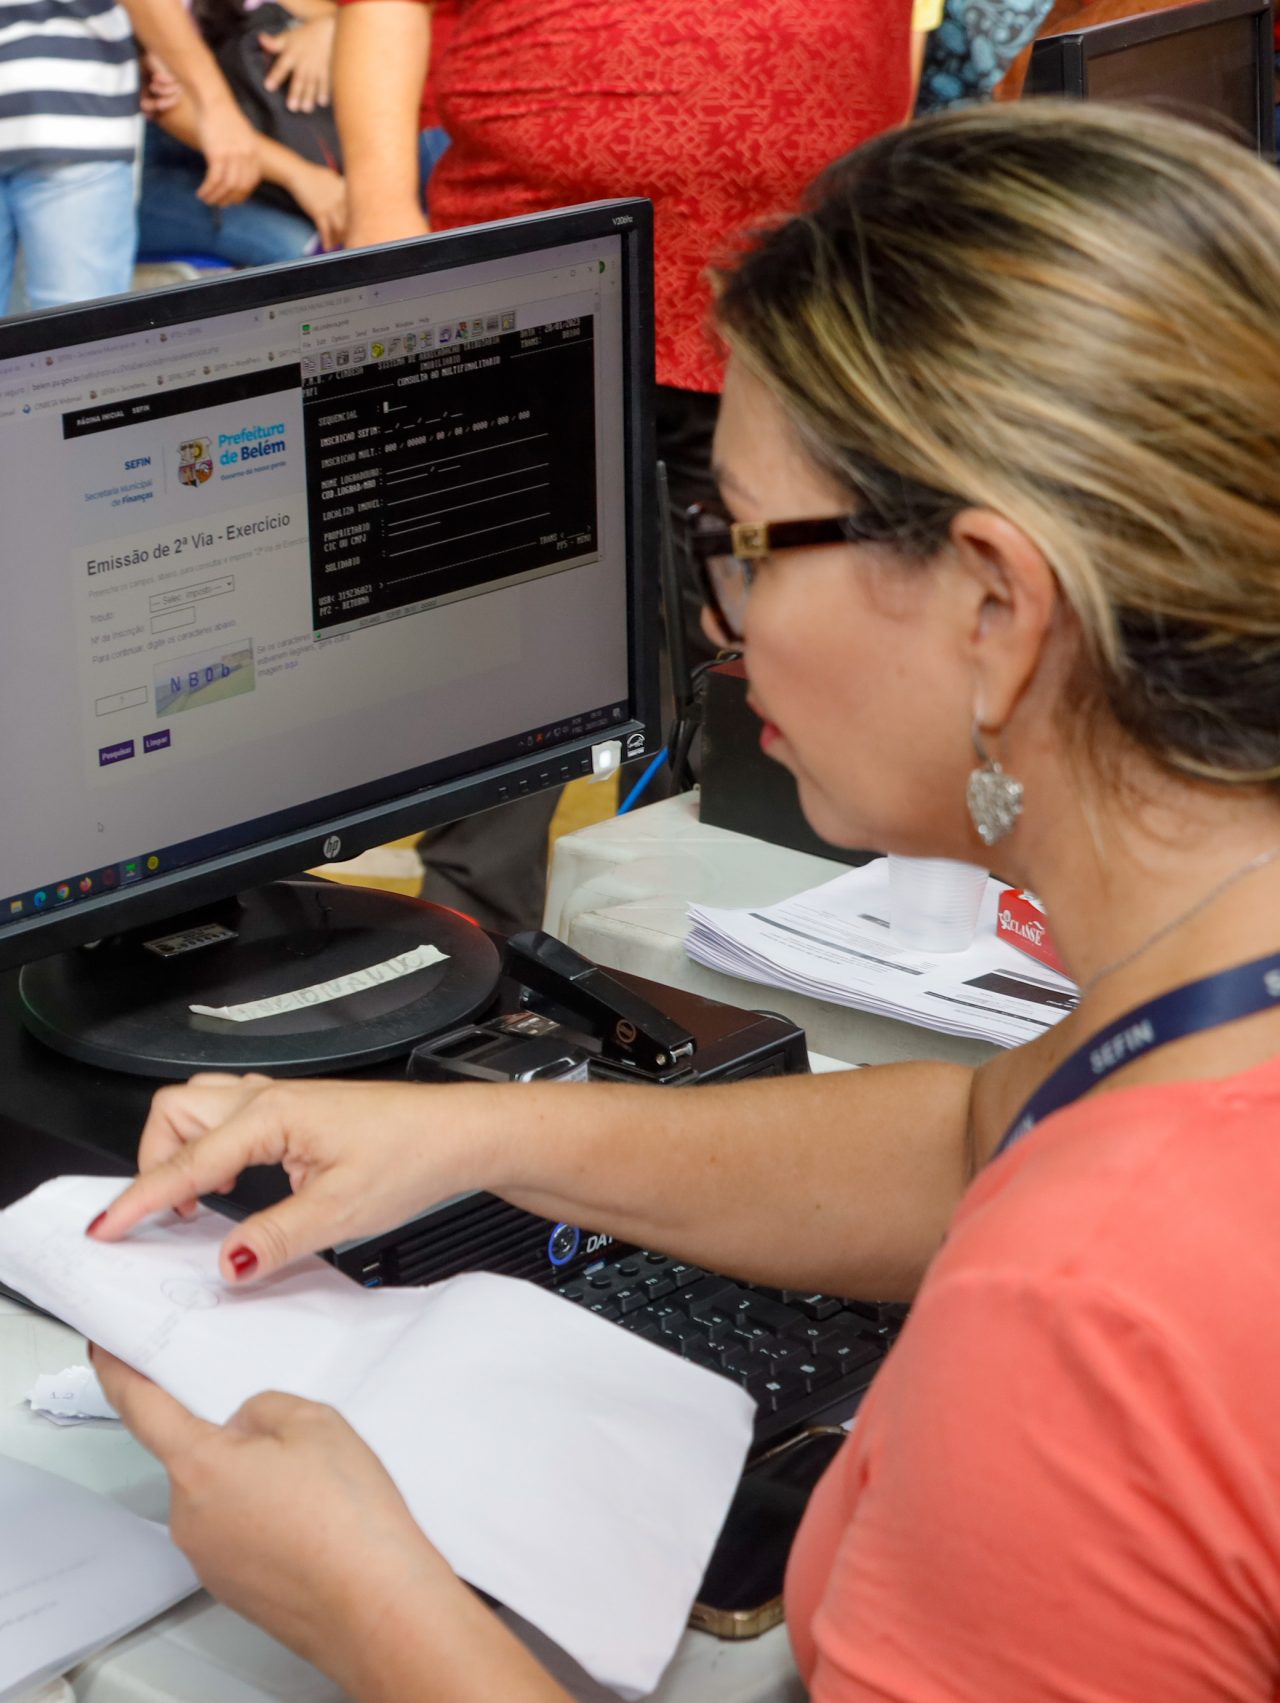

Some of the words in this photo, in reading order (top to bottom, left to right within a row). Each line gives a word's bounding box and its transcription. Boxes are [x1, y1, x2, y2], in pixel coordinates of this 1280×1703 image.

[131, 403, 150, 414] SEFIN
[219, 422, 286, 448] Prefeitura
[124, 456, 152, 471] SEFIN
[220, 449, 238, 466] de
[241, 439, 286, 461] Belém
[122, 490, 154, 505] Finanças
[87, 550, 149, 575] Emissão
[153, 544, 169, 559] de
[174, 537, 187, 554] 2ª
[192, 533, 213, 548] Via
[227, 514, 290, 540] Exercício
[324, 836, 341, 858] hp
[1090, 1018, 1155, 1075] SEFIN
